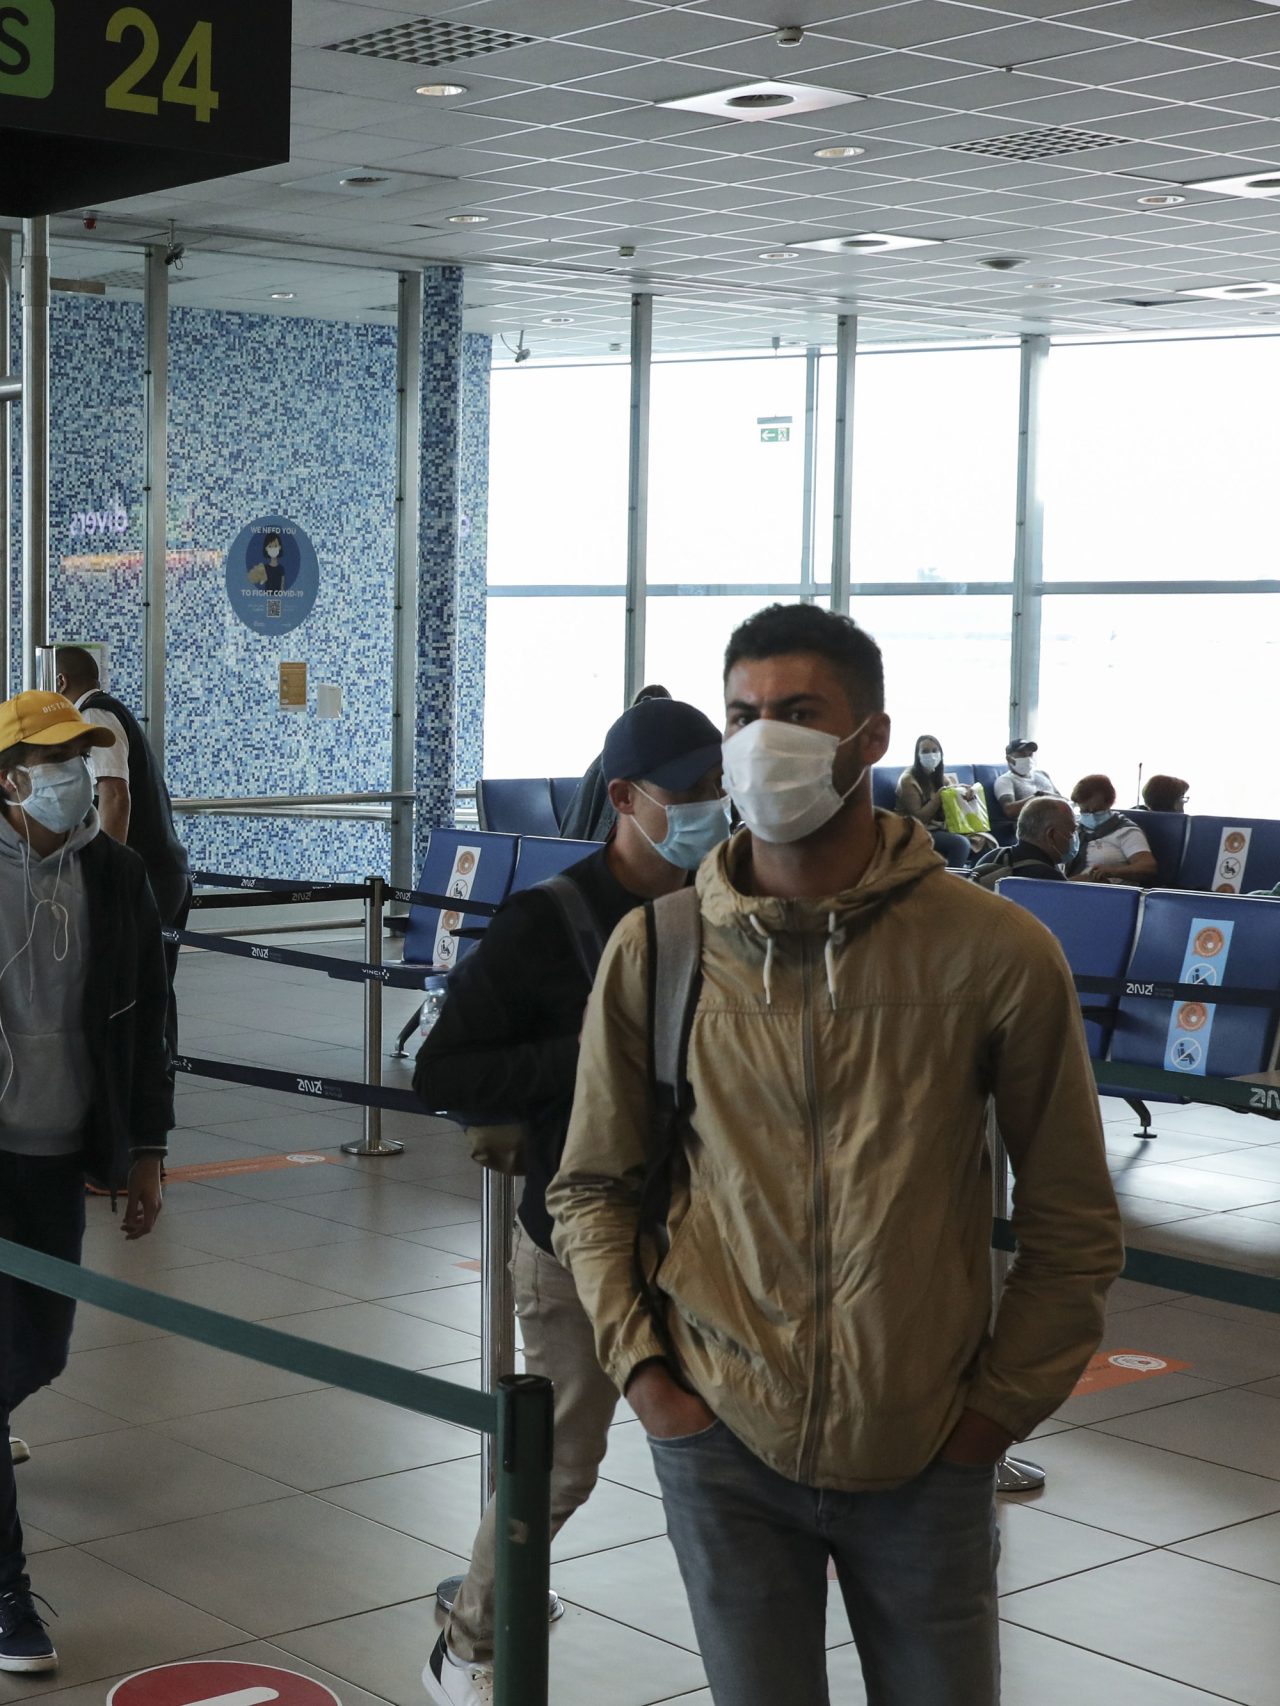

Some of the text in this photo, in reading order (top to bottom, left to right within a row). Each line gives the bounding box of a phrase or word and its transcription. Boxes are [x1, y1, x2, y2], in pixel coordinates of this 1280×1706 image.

[105, 6, 219, 123] 24
[251, 526, 297, 535] WE NEED YOU
[274, 590, 304, 598] COVID-19
[362, 968, 381, 977] VINCI
